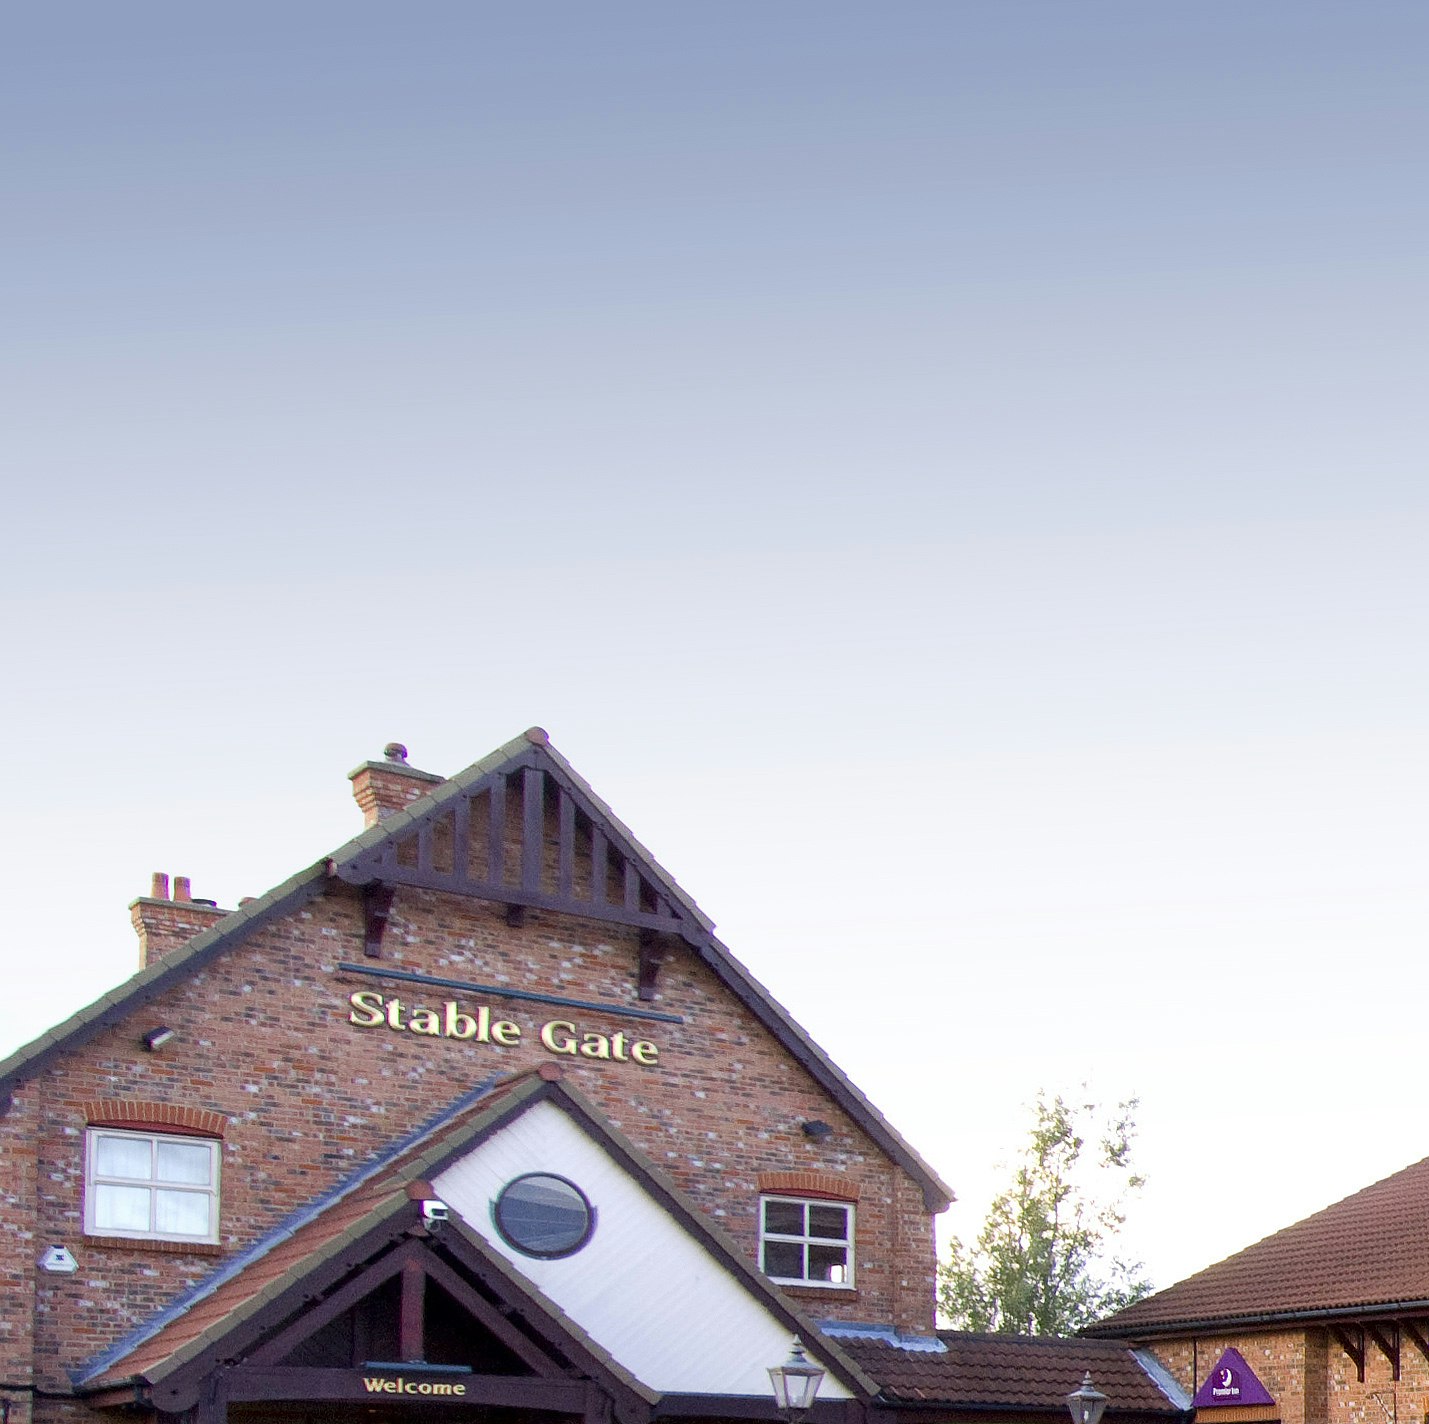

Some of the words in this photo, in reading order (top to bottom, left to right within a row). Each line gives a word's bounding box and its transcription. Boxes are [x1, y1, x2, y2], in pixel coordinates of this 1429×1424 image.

[349, 990, 521, 1046] Stable
[540, 1020, 659, 1066] Gate
[363, 1377, 466, 1396] Welcome
